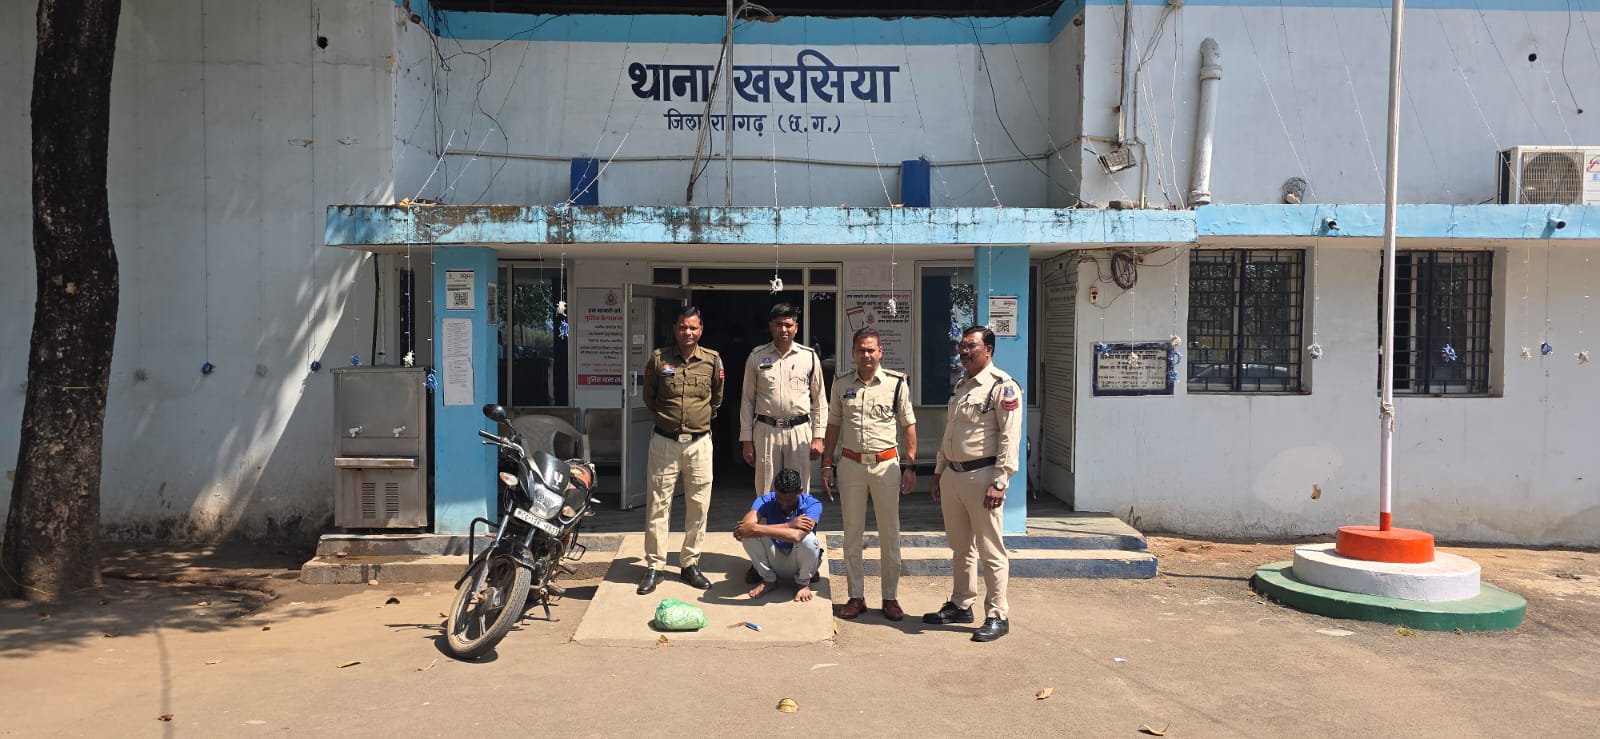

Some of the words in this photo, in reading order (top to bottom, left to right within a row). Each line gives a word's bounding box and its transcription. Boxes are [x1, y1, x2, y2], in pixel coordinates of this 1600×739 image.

[628, 62, 714, 102] थाना
[732, 49, 900, 103] खरसिया
[663, 108, 704, 131] जिला
[709, 114, 767, 137] रागढ़
